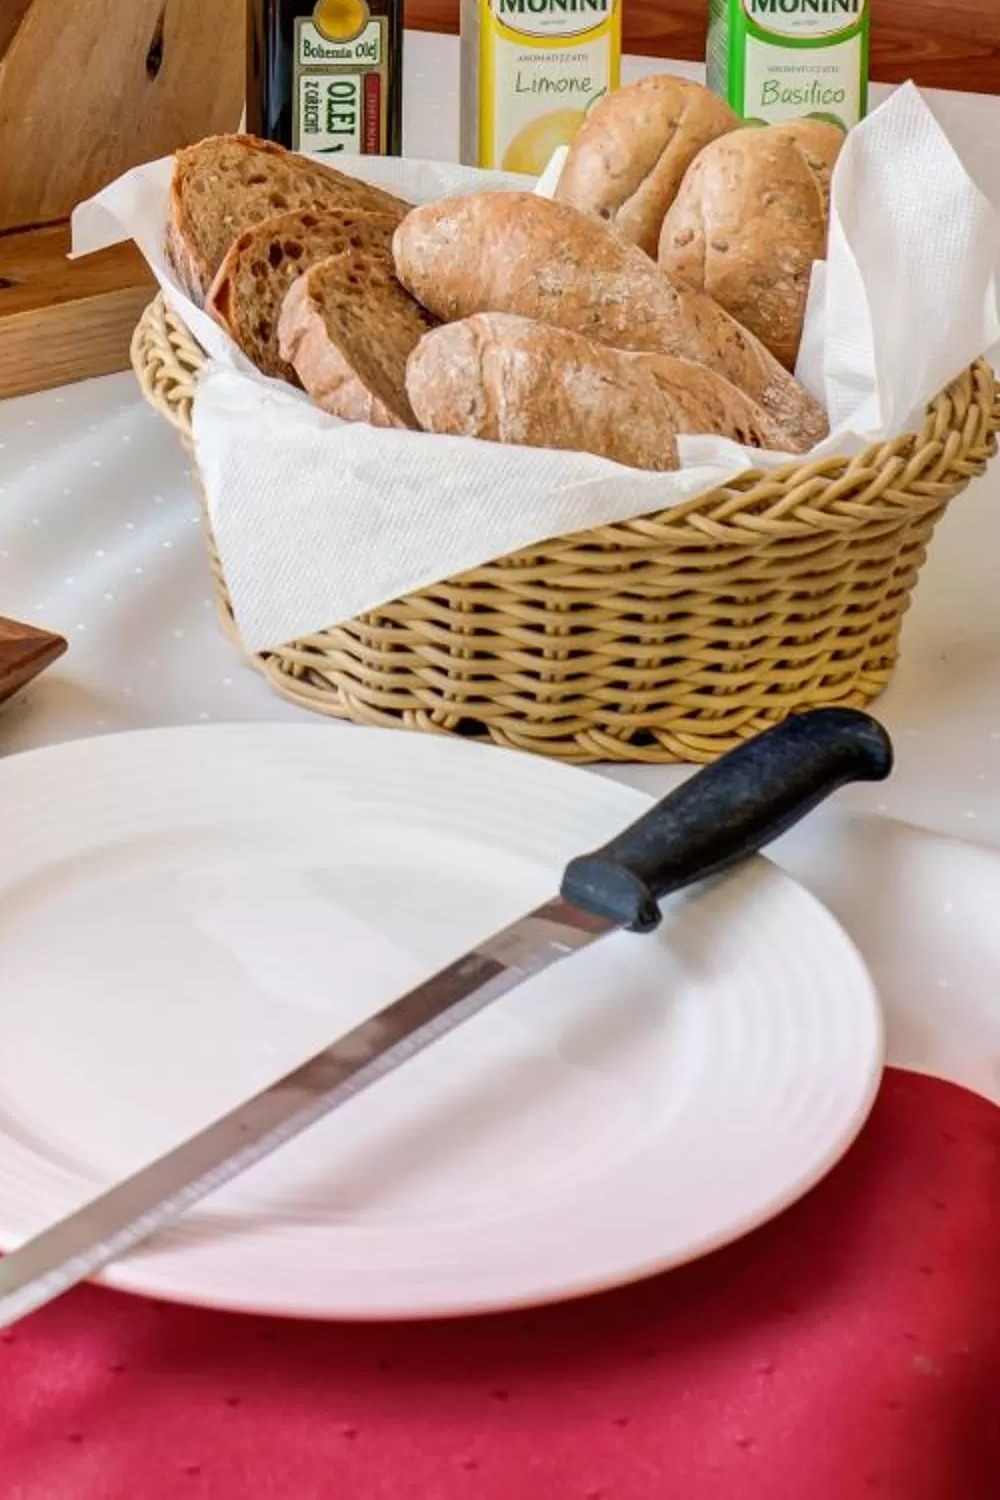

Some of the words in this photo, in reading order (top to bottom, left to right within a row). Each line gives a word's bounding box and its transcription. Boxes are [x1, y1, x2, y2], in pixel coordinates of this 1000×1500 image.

[303, 39, 352, 59] Bohemia
[355, 40, 377, 60] Olej
[515, 71, 593, 93] Limone
[760, 79, 846, 106] Basilico
[327, 81, 357, 135] OLEJ
